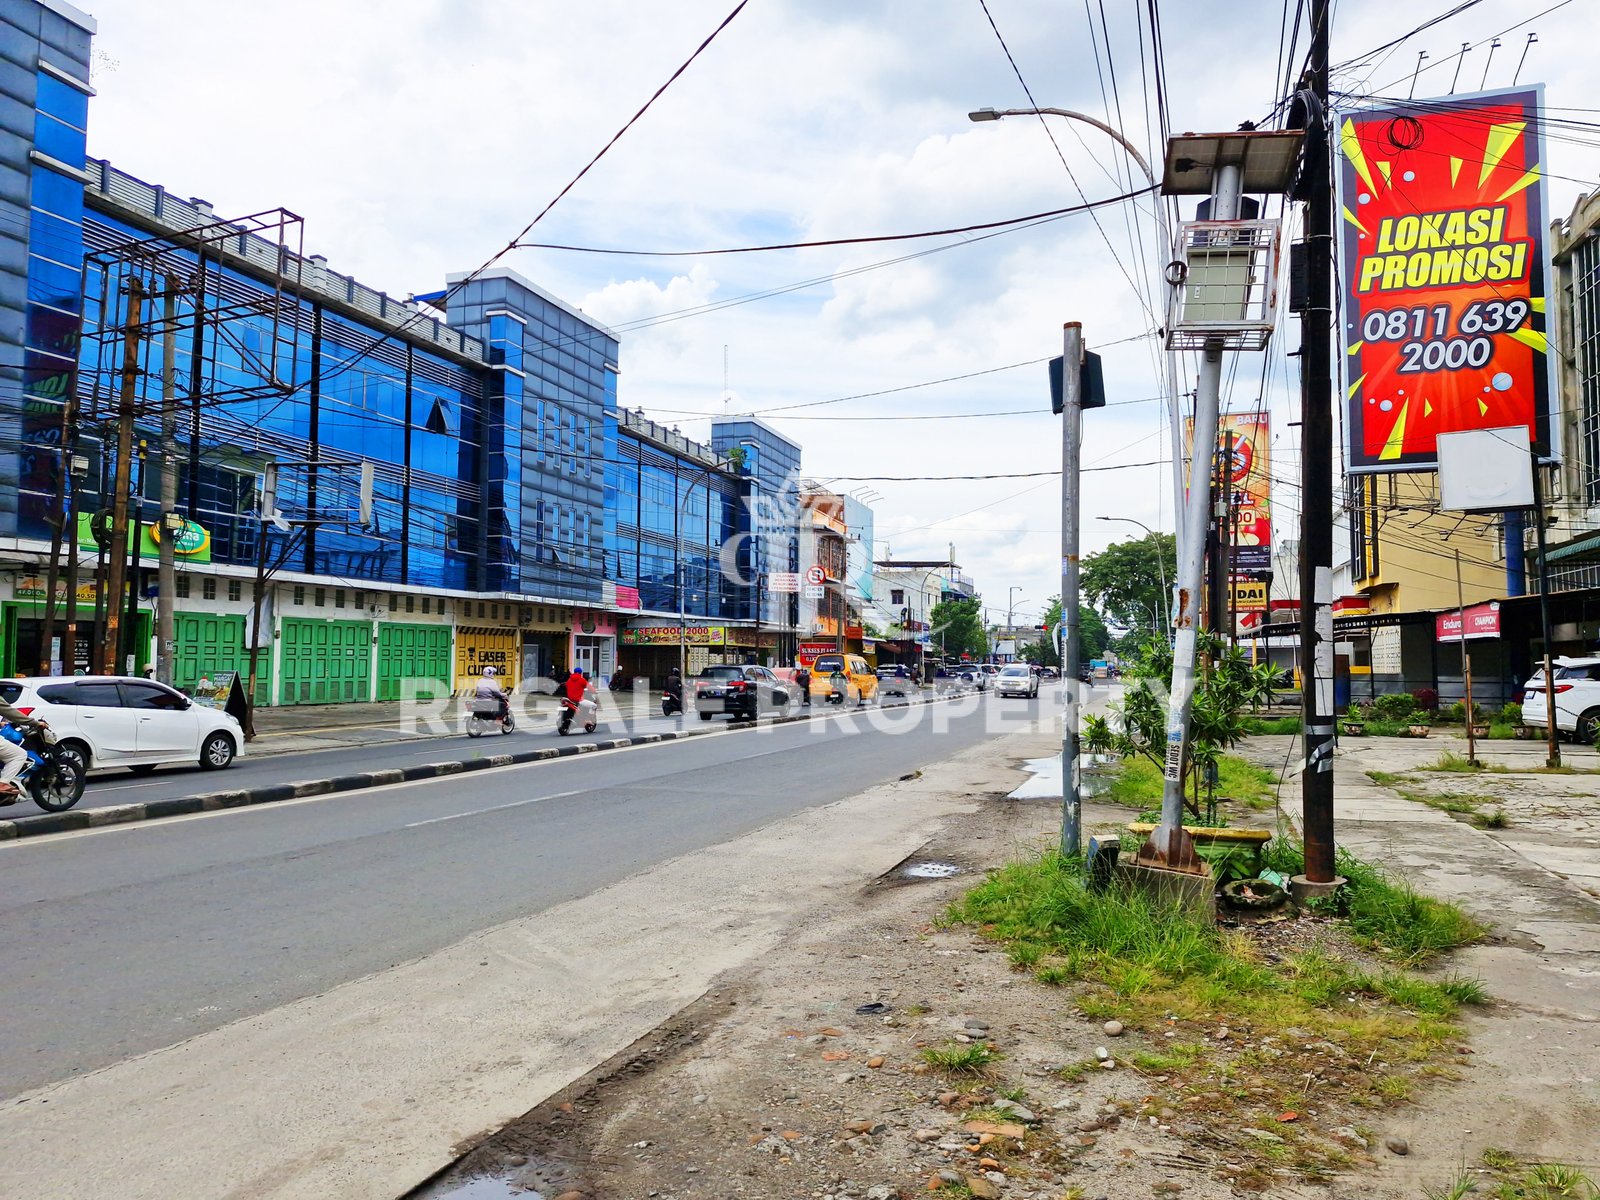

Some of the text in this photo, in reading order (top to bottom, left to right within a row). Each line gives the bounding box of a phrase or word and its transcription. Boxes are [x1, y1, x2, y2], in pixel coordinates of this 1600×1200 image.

[1378, 208, 1505, 253] LOKASI
[1359, 243, 1527, 292] PROMOSI
[1363, 300, 1528, 342] 0811 639
[1400, 337, 1491, 372] 2000
[1236, 413, 1268, 425] BARU
[638, 627, 682, 635] SEAFOOD
[686, 627, 709, 635] 2000
[478, 651, 506, 662] LASER
